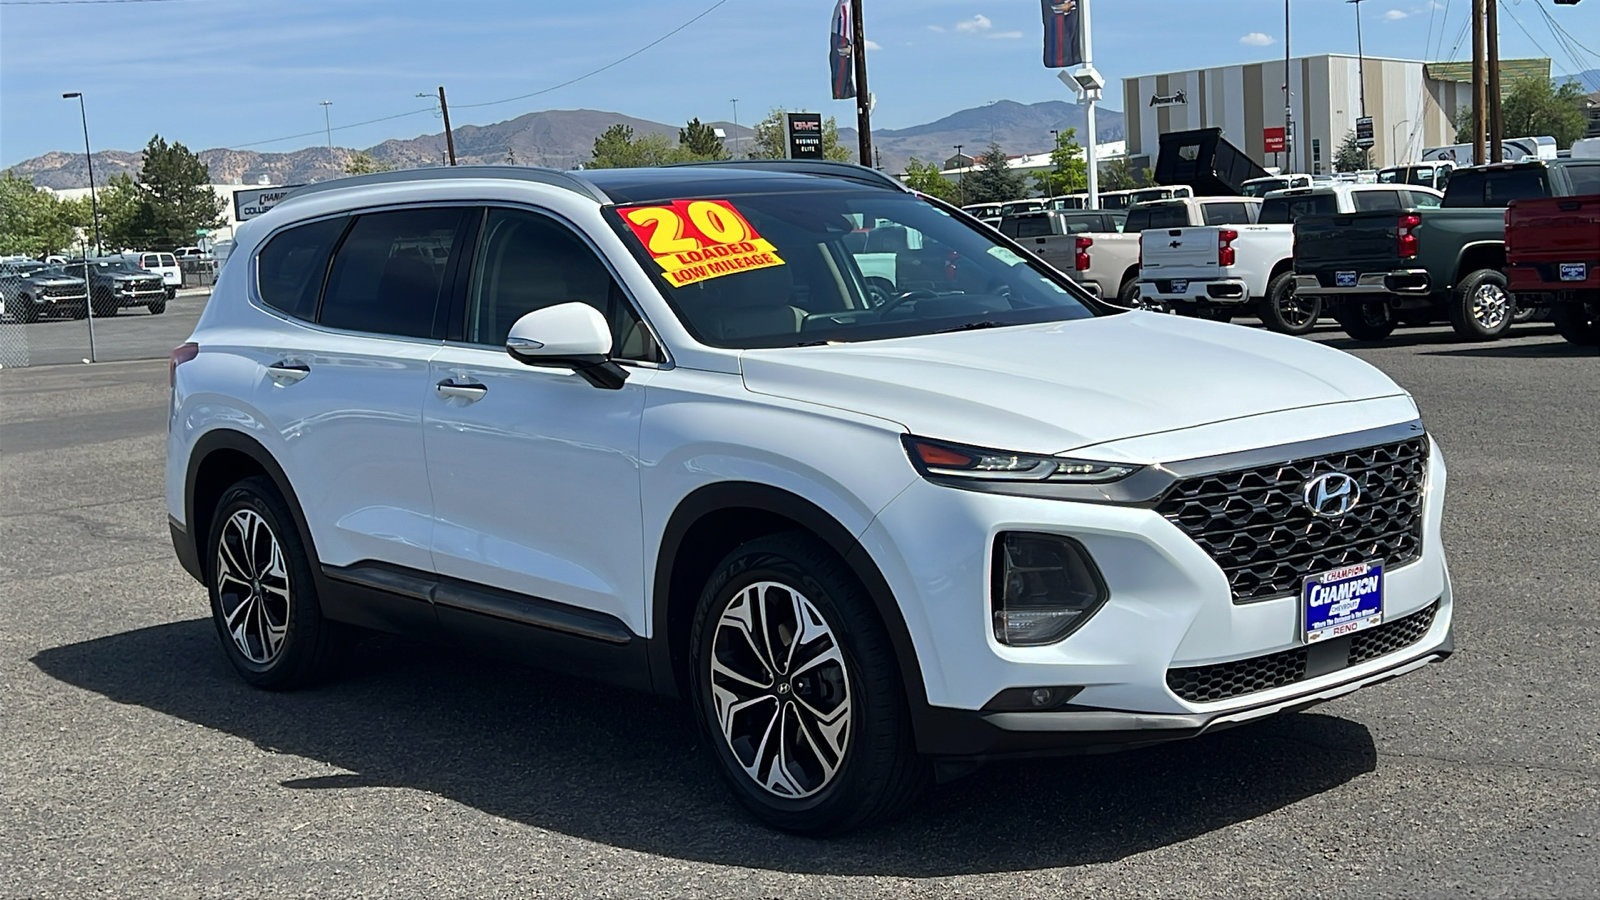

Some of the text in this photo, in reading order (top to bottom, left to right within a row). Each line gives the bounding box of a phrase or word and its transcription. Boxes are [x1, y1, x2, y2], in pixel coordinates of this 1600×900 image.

[794, 121, 819, 130] GMC
[627, 201, 751, 254] 20
[676, 241, 758, 265] LOADED
[671, 253, 775, 283] LOW MILEAGE
[1326, 565, 1364, 581] CHAMPION
[1310, 575, 1378, 607] CHAMPION
[1333, 622, 1358, 635] RENO
